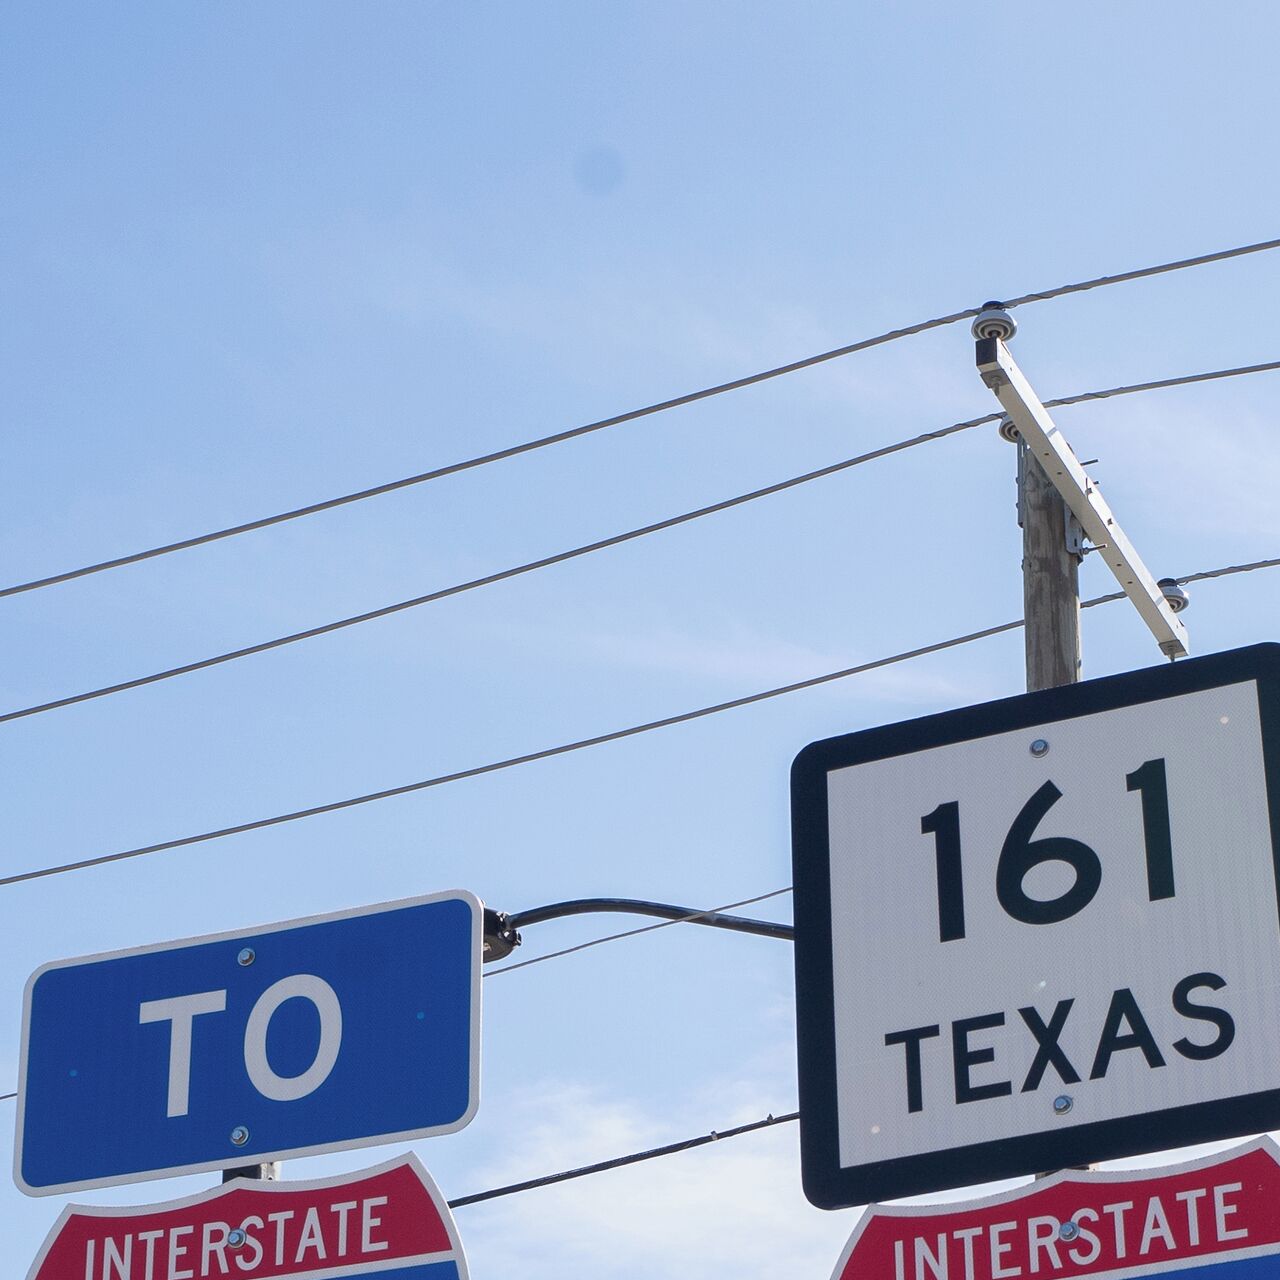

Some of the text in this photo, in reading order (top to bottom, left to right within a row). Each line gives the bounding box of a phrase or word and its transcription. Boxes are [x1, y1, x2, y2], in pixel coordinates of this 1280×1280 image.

[921, 757, 1176, 943] 161
[138, 973, 343, 1118] TO
[884, 971, 1236, 1114] TEXAS
